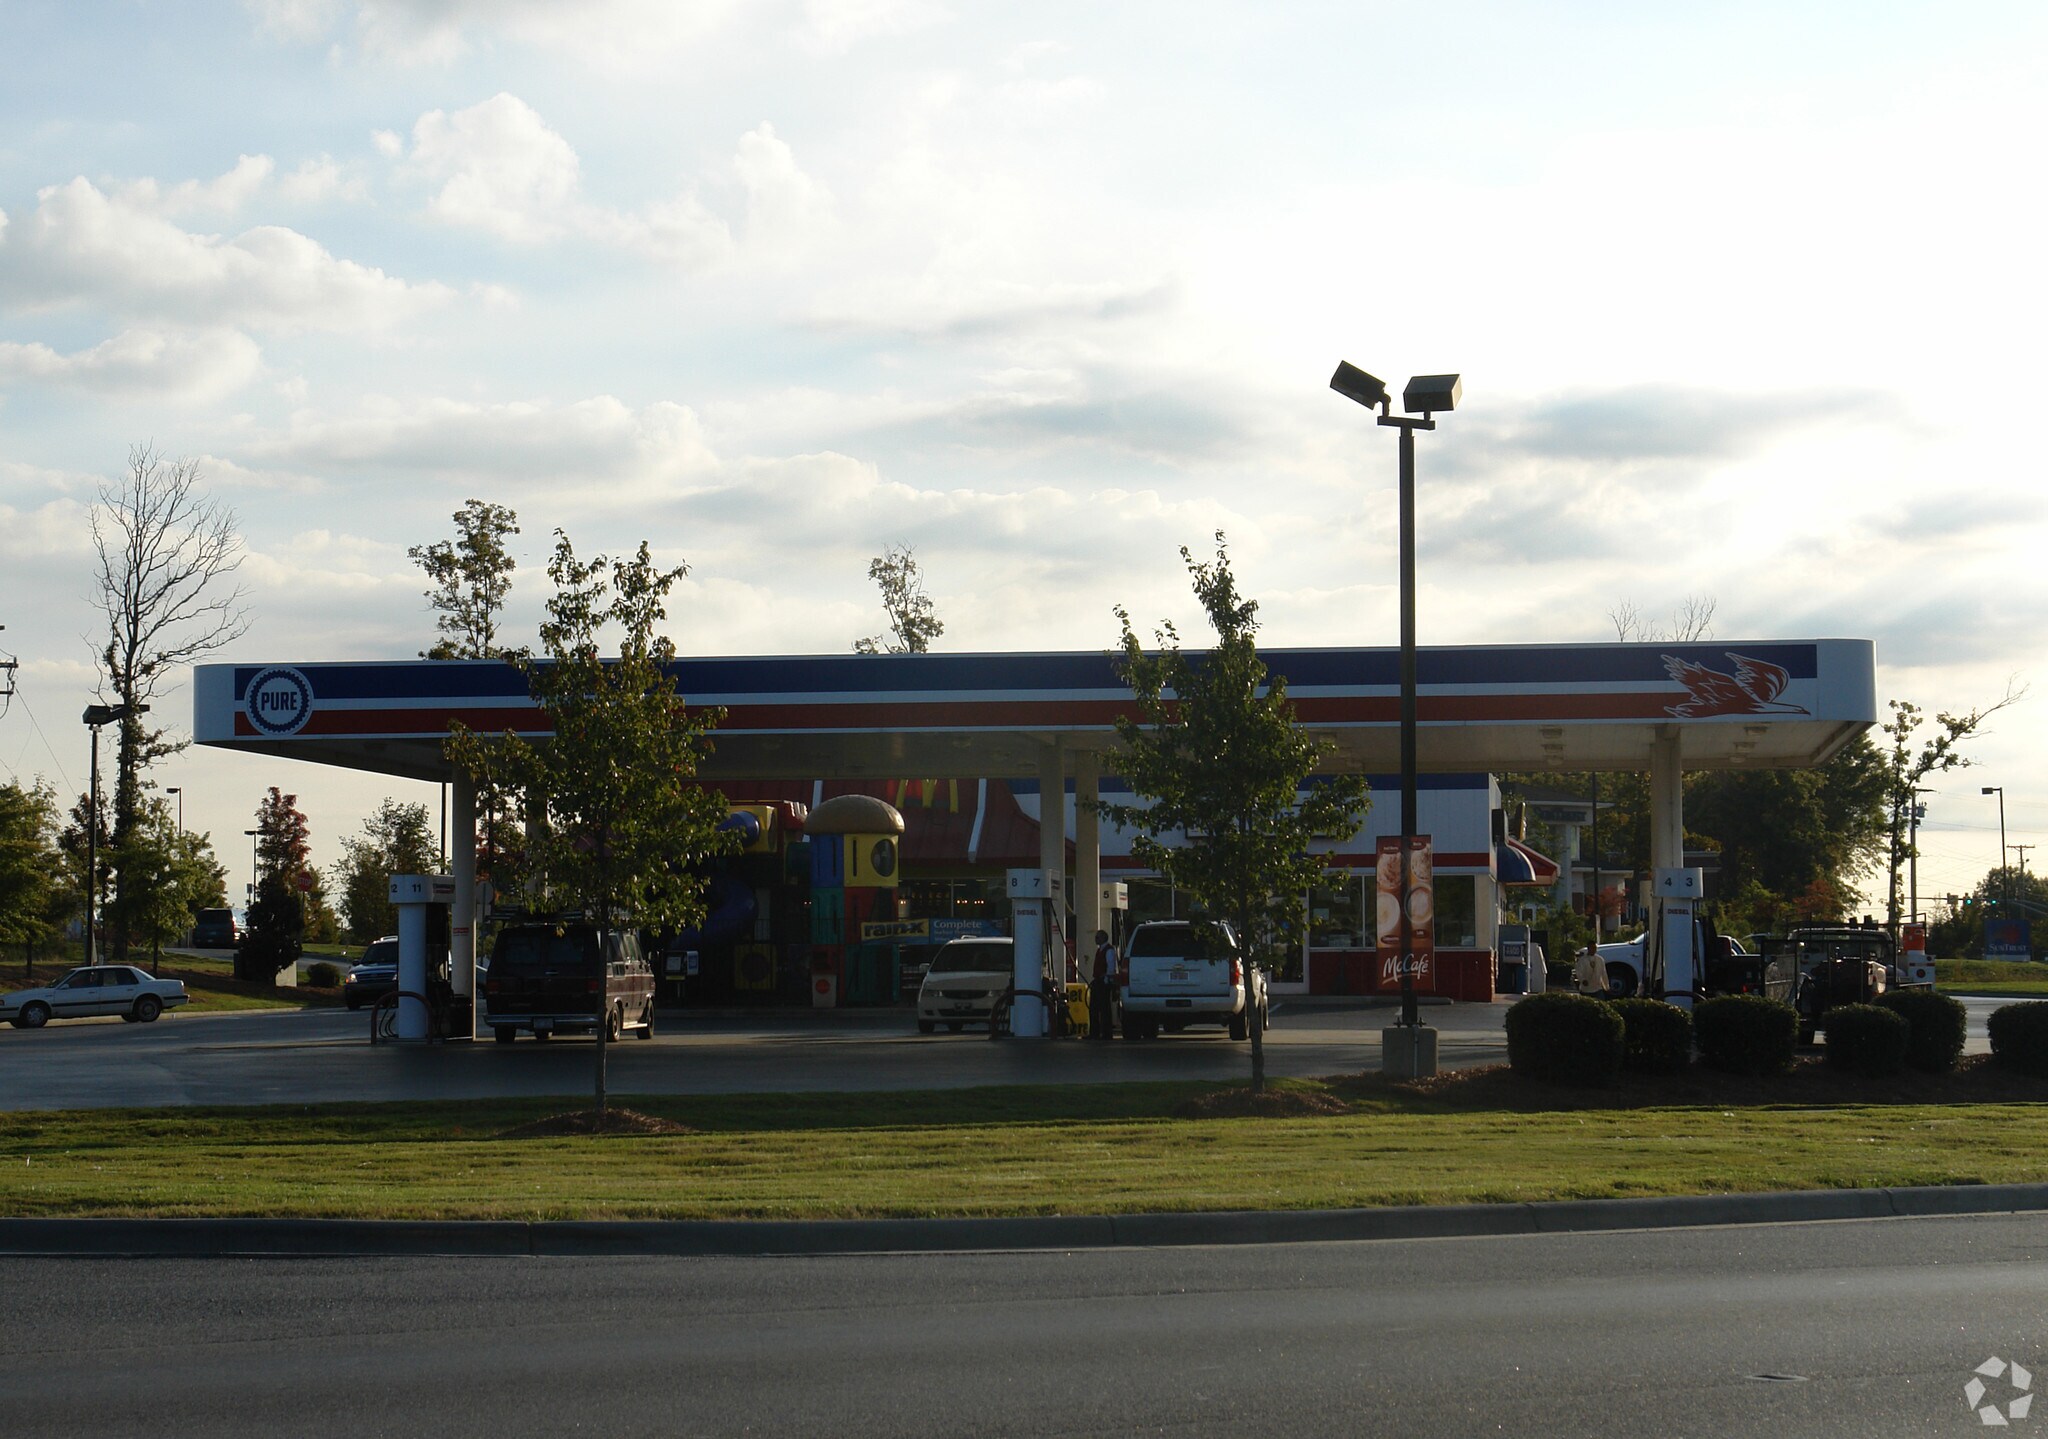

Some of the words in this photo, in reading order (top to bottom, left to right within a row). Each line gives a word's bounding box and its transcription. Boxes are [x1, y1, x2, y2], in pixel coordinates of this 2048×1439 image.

[261, 691, 298, 711] PURE
[1011, 878, 1018, 887] 8
[1033, 878, 1040, 887] 7
[1664, 877, 1672, 887] 4
[1686, 877, 1693, 887] 3
[411, 883, 422, 893] 11
[1103, 890, 1110, 899] 5
[933, 919, 982, 930] Complete
